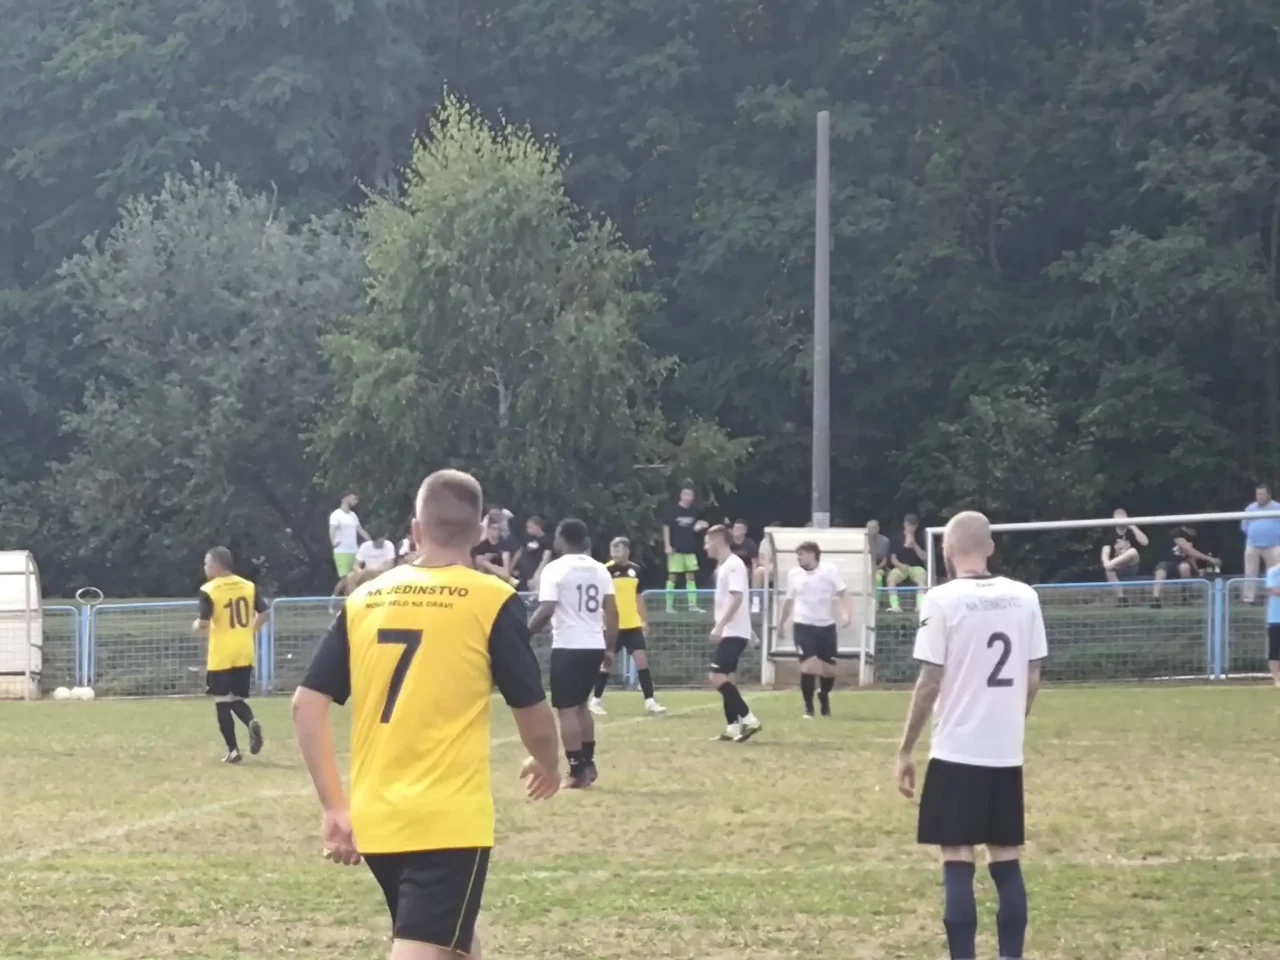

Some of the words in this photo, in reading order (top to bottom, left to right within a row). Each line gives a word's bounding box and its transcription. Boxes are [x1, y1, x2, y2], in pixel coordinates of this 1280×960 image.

[387, 584, 470, 598] JEDINSTVO
[412, 600, 424, 608] NA
[426, 600, 454, 609] DRAVI
[576, 584, 600, 613] 18
[223, 596, 250, 630] 10
[986, 631, 1015, 688] 2
[377, 628, 424, 724] 7
